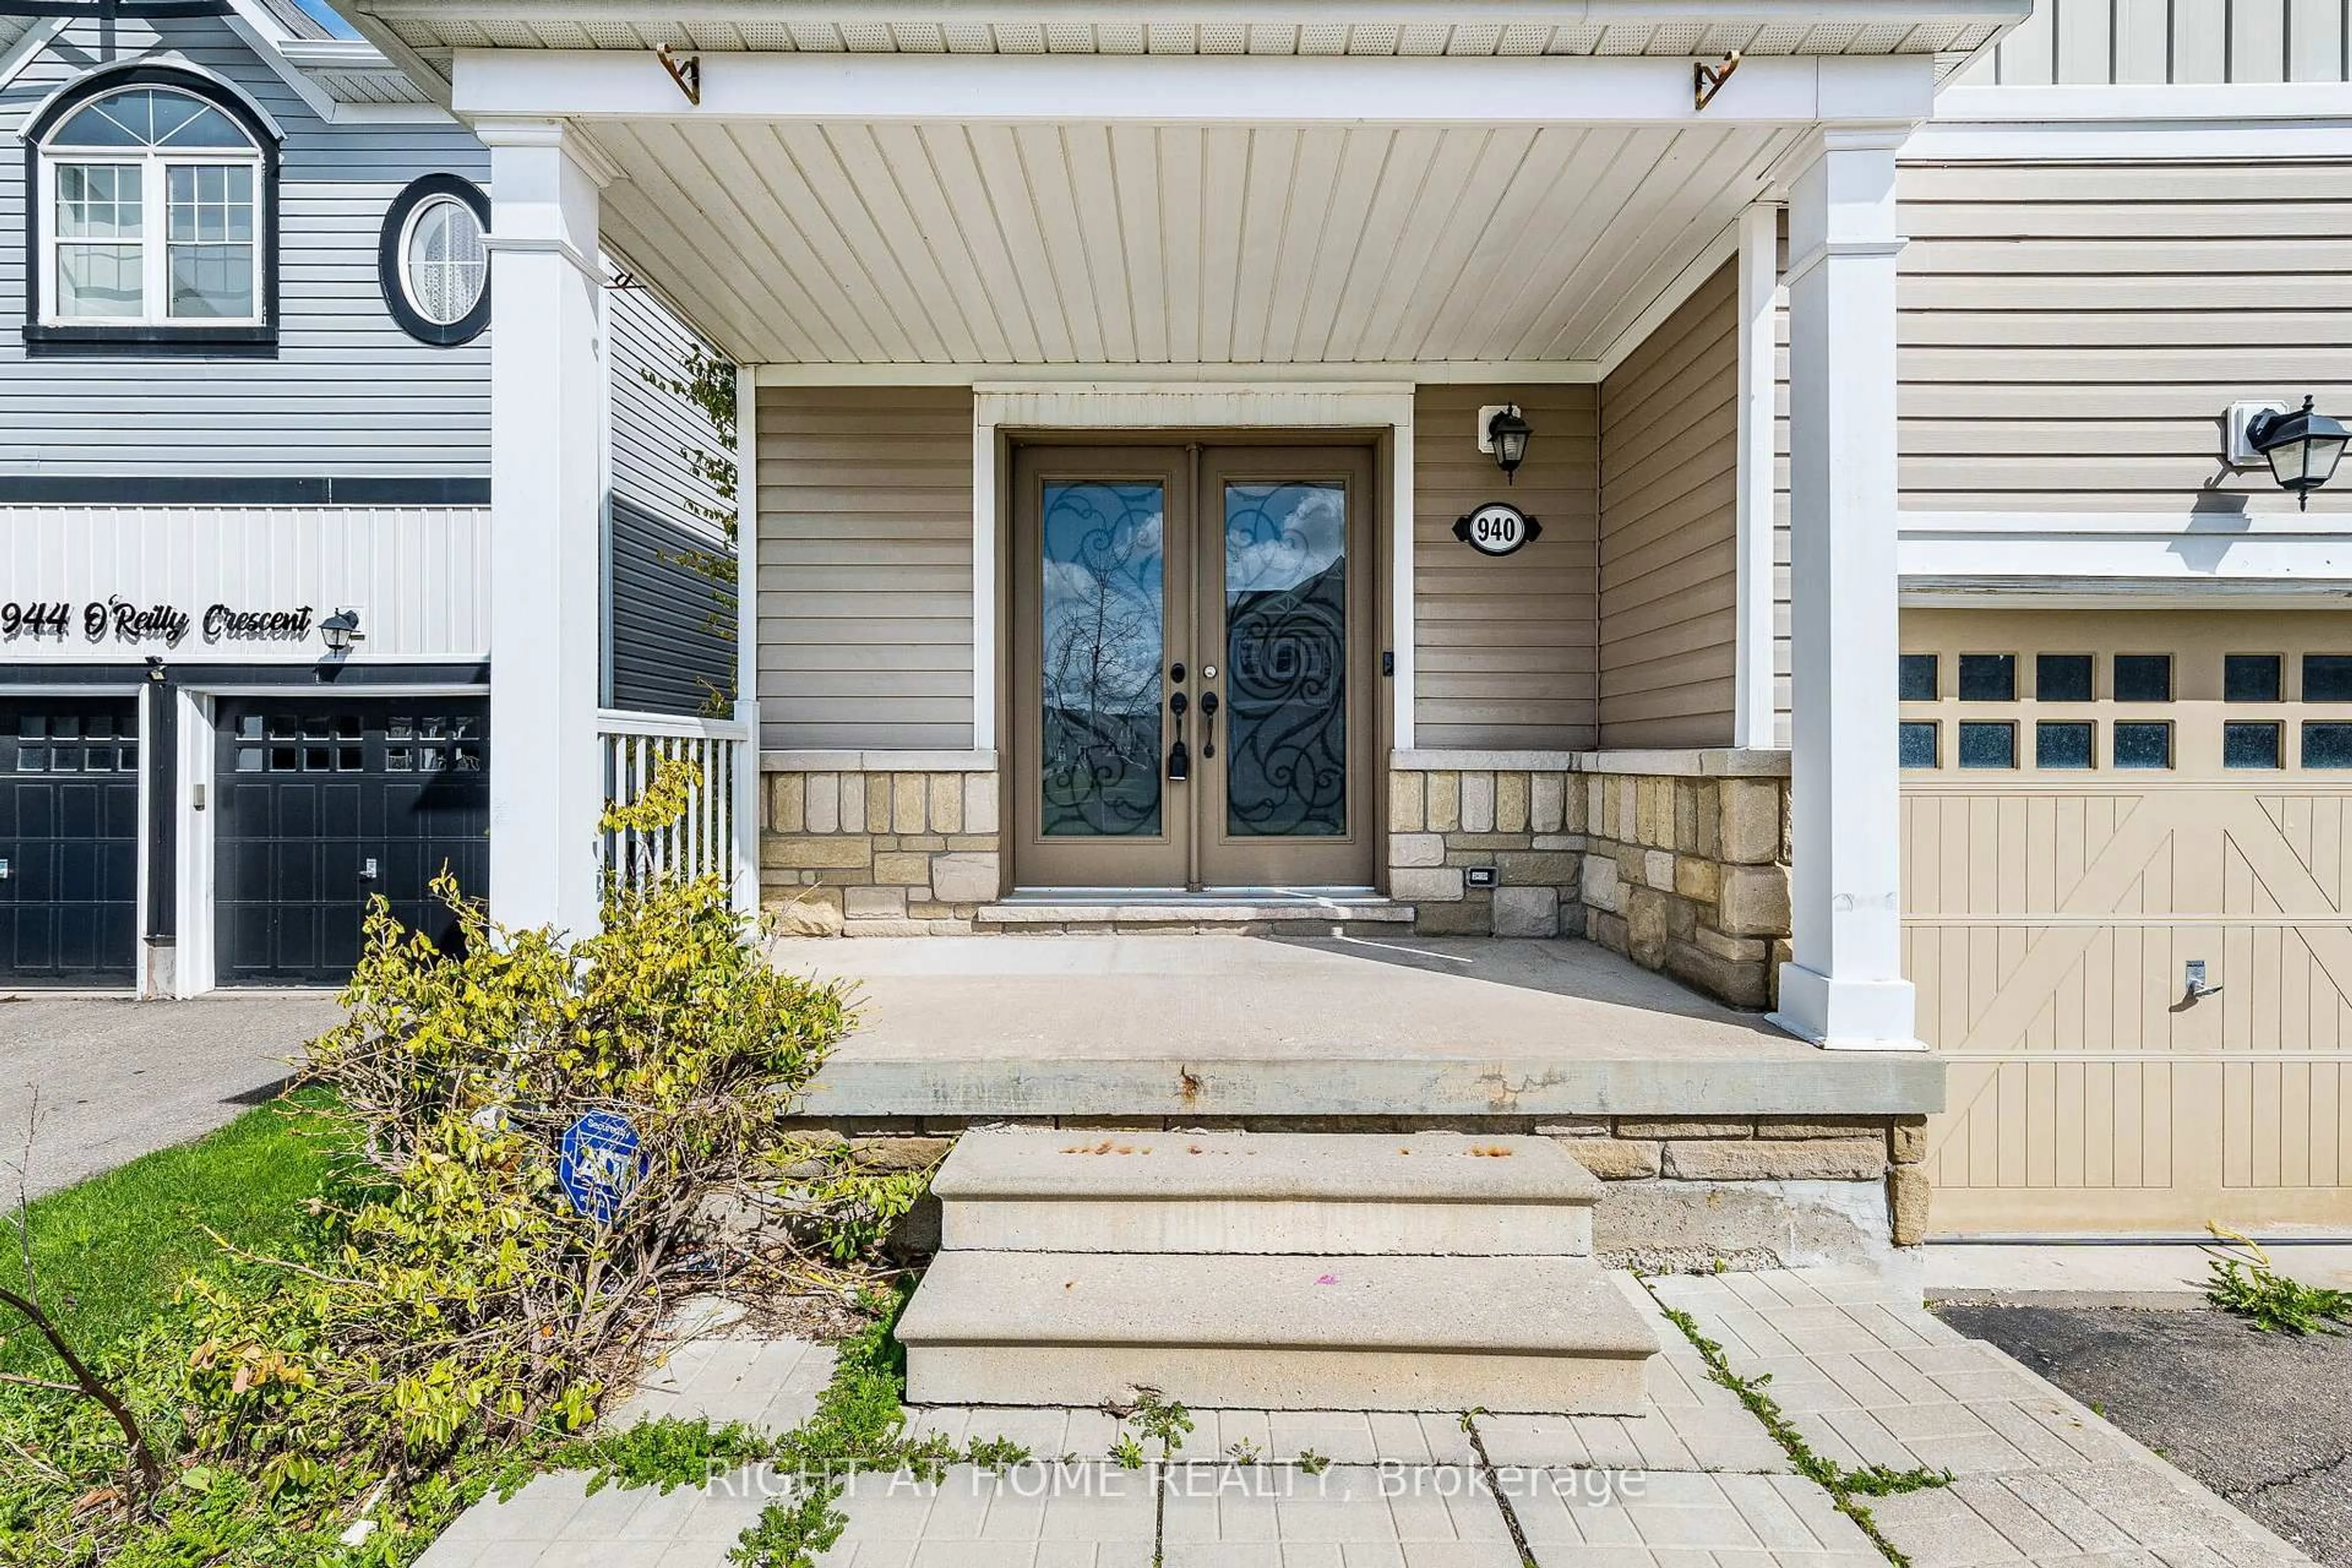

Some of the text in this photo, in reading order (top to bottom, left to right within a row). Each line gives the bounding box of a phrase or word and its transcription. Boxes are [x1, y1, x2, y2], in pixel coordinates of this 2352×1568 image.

[1477, 518, 1515, 542] 940
[1, 594, 313, 641] 944 O'Reilly Crescent
[575, 1148, 631, 1191] ADT
